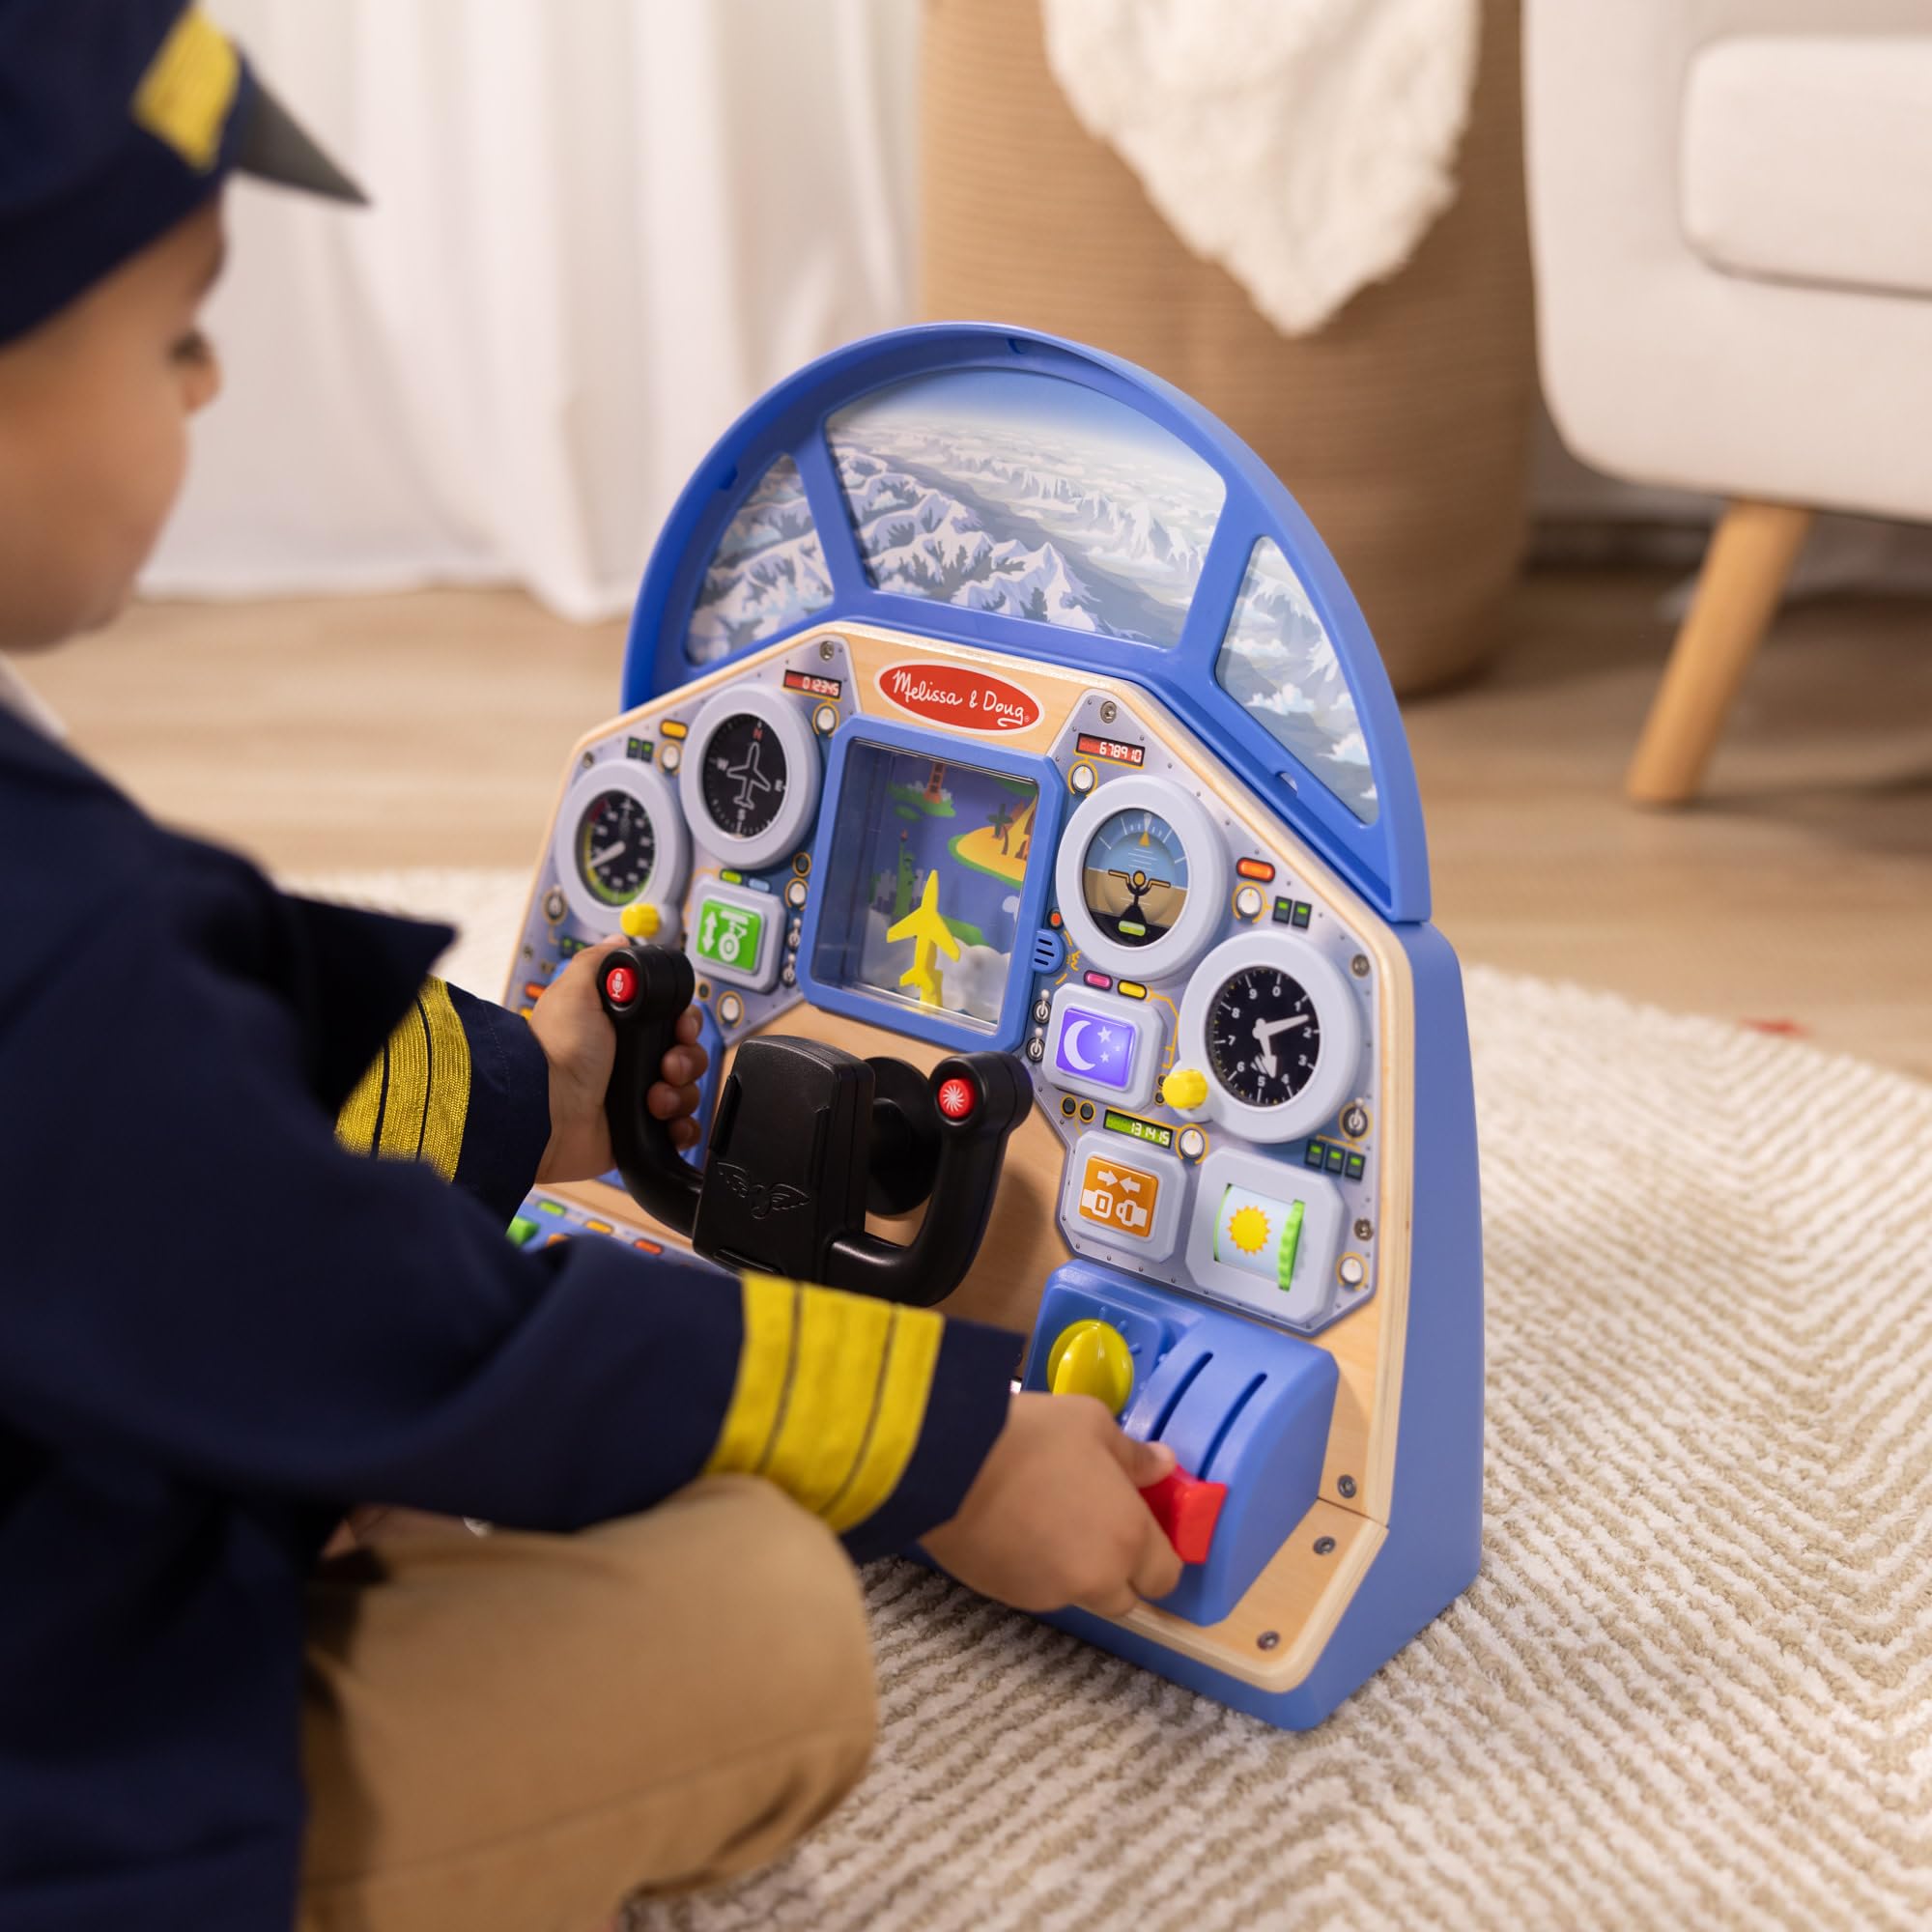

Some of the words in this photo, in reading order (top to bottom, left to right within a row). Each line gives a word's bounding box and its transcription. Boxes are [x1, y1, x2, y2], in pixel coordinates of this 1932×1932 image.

[892, 669, 963, 706] Melissa
[969, 690, 978, 709] &
[1248, 988, 1258, 1000] 9
[1272, 985, 1281, 998] 0
[1294, 1001, 1301, 1012] 1
[1231, 1008, 1240, 1019] 8
[1302, 1027, 1312, 1038] 2
[1228, 1035, 1236, 1046] 7
[1297, 1054, 1307, 1066] 3
[1236, 1061, 1245, 1072] 6
[1257, 1075, 1266, 1087] 5
[1281, 1073, 1290, 1085] 4
